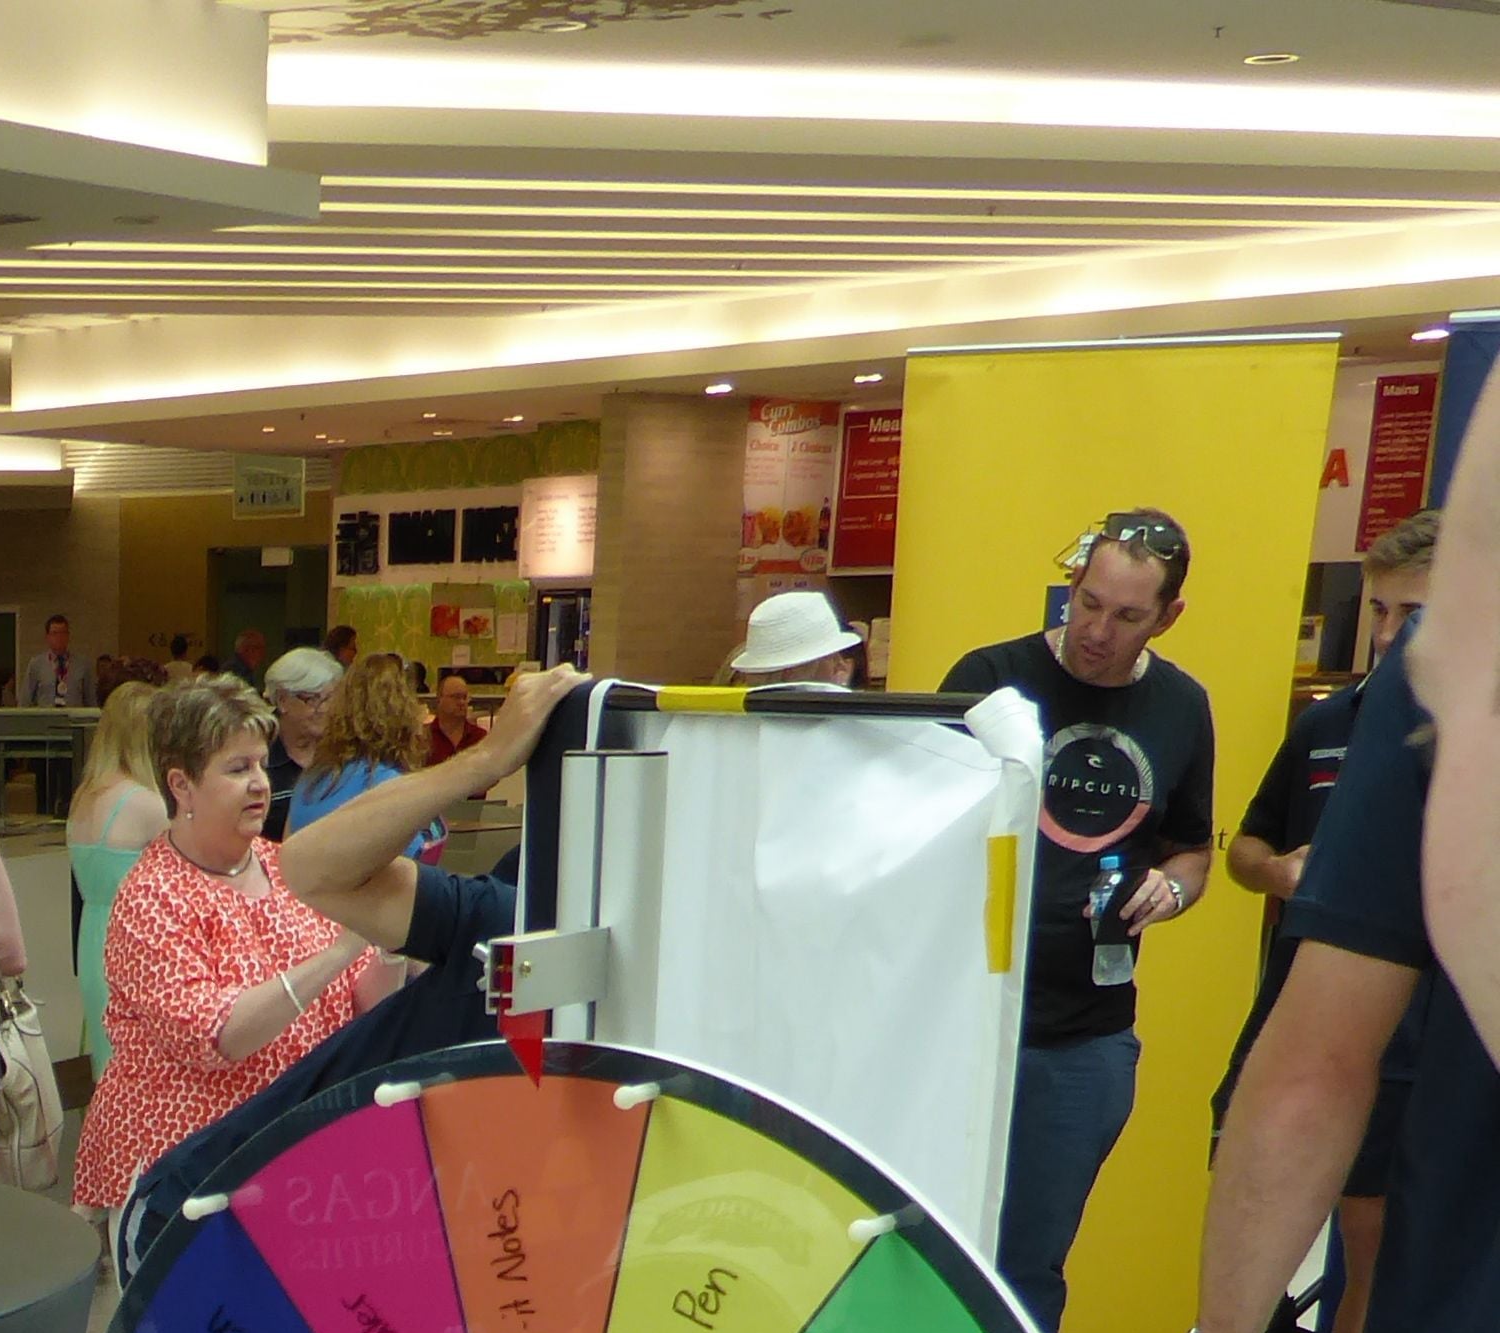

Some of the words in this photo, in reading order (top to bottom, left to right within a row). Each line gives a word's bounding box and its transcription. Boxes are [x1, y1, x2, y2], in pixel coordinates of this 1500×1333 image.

[760, 402, 795, 423] Curry
[769, 415, 822, 437] Combos
[868, 416, 902, 433] Mea
[487, 1187, 530, 1284] Notes
[671, 1266, 739, 1331] Pen
